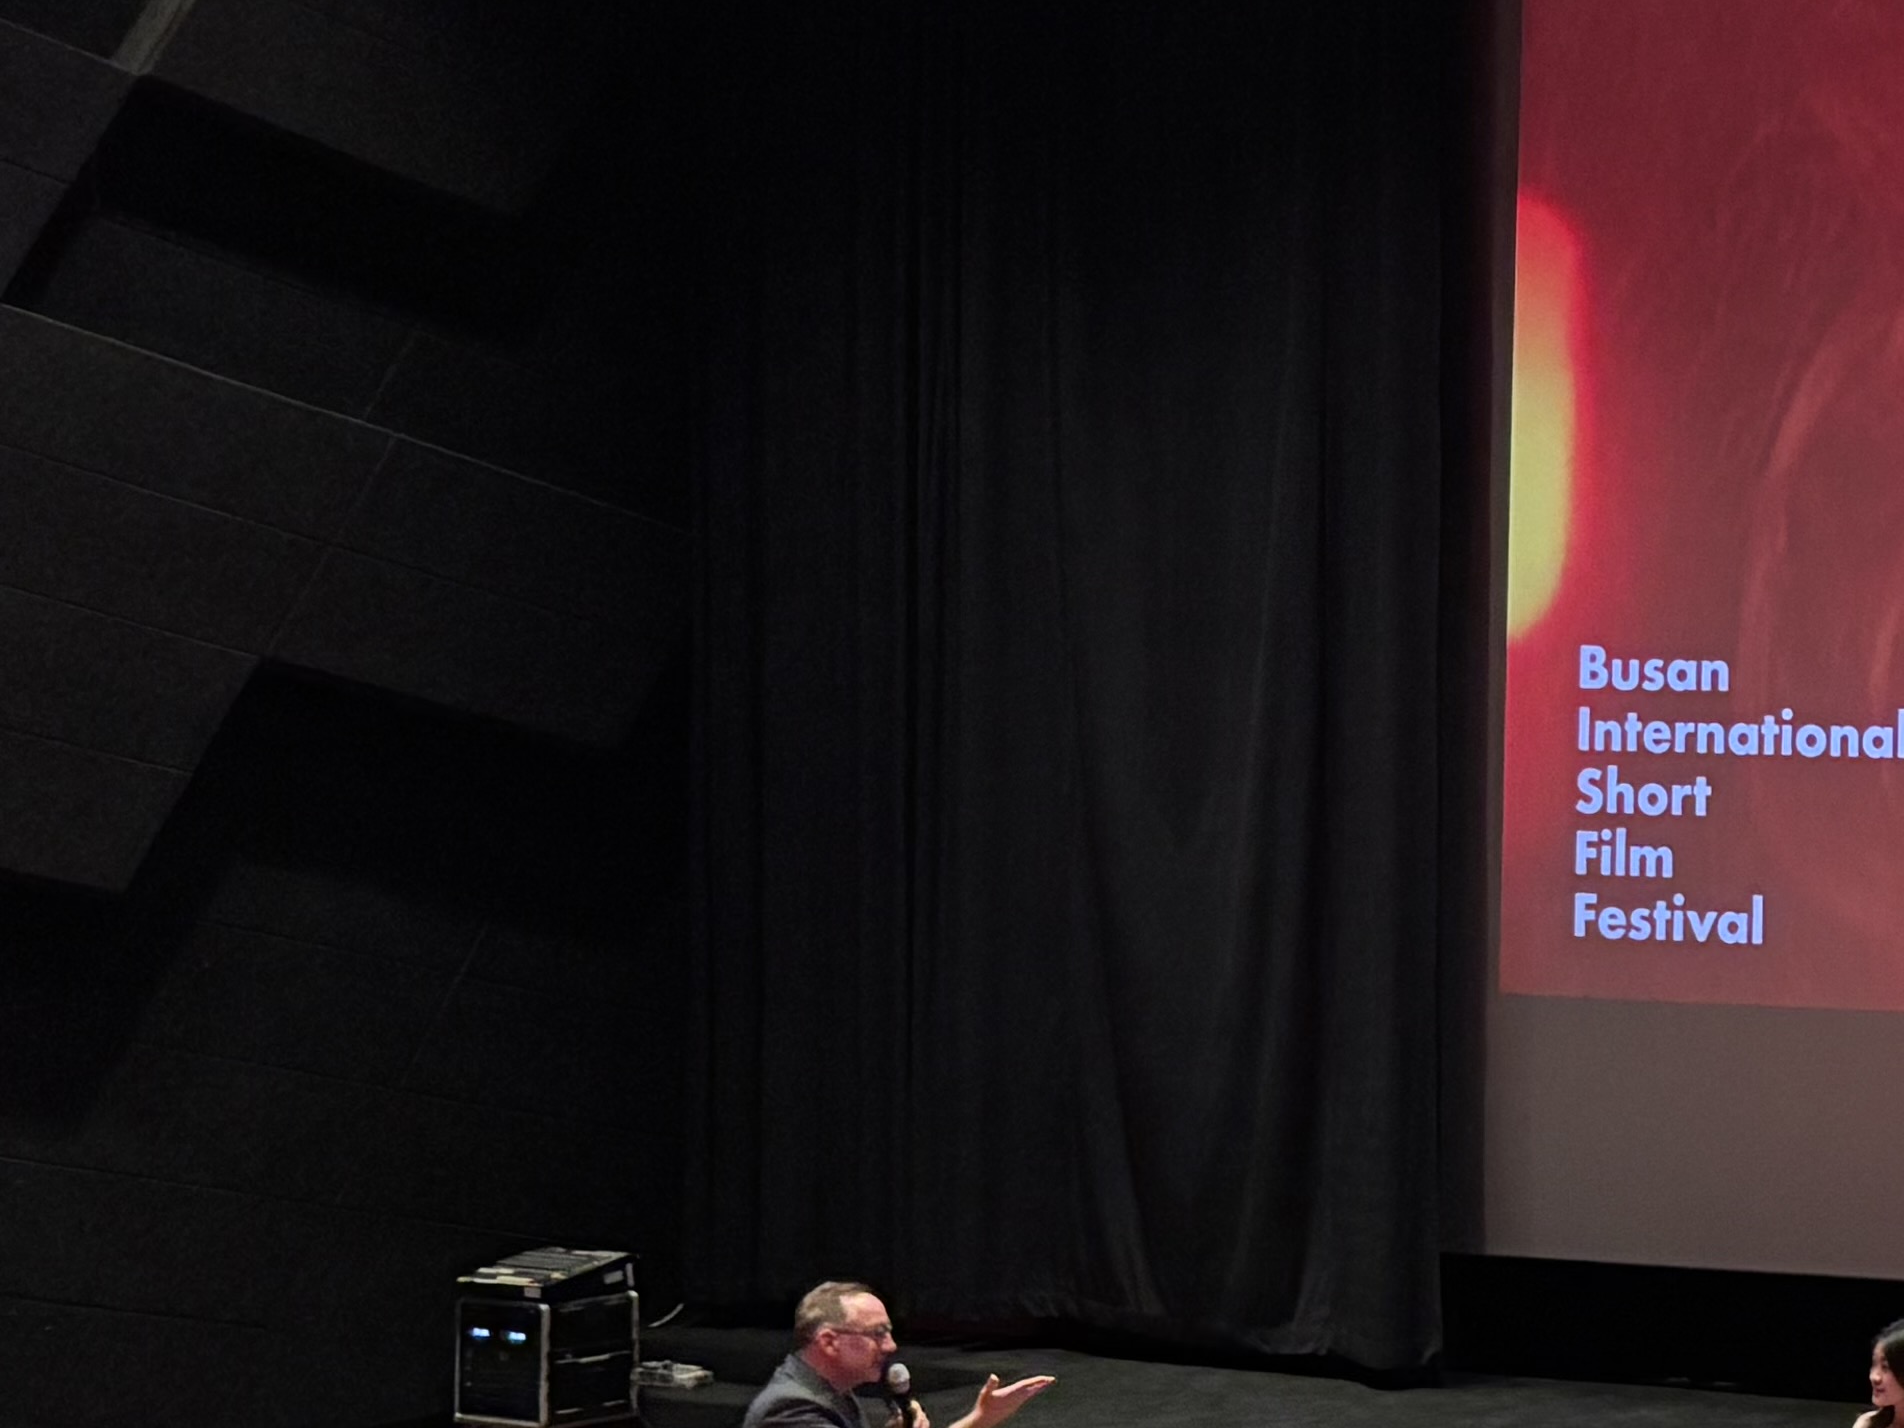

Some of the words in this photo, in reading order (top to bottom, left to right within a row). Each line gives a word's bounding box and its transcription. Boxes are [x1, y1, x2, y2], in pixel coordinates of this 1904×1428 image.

[1579, 645, 1730, 692] Busan
[1575, 765, 1712, 817] Short
[1573, 827, 1674, 878] Film
[1573, 893, 1764, 946] Festival
